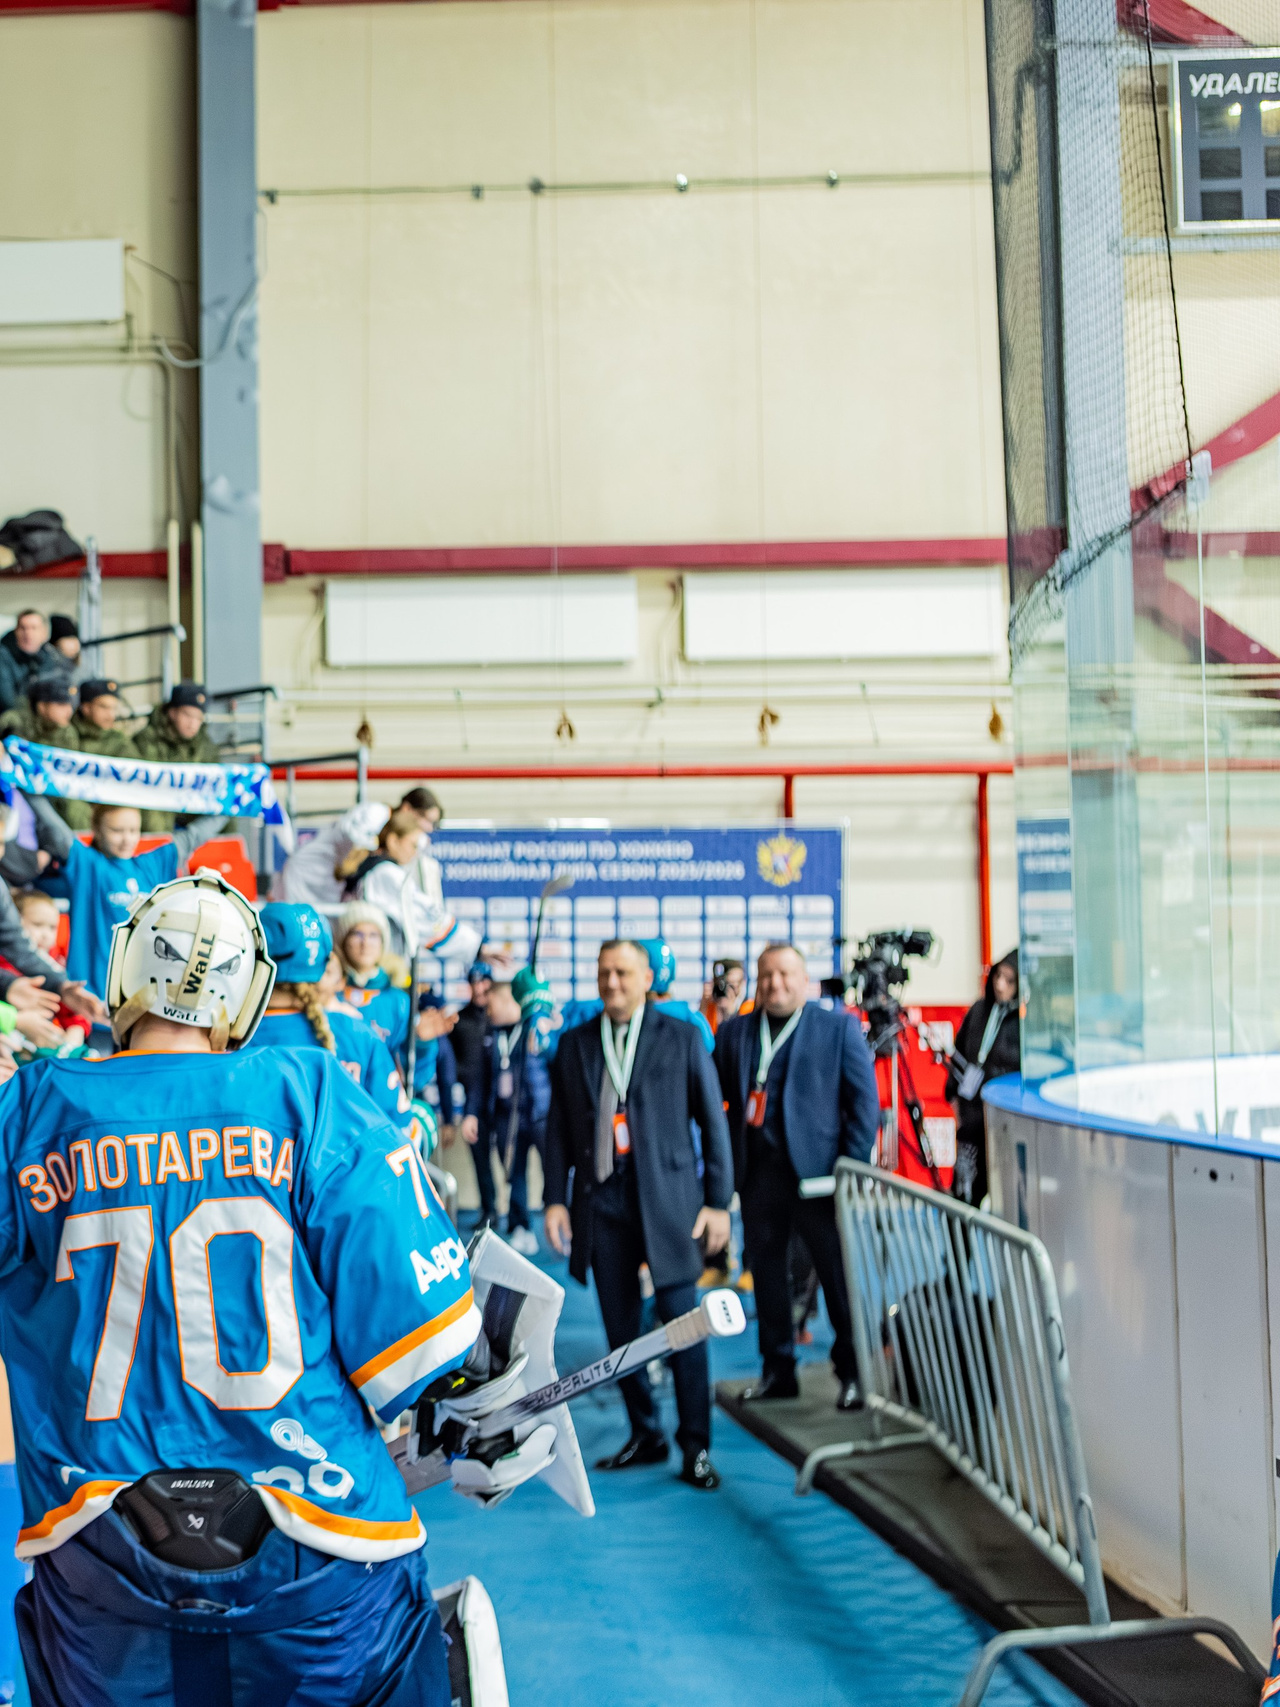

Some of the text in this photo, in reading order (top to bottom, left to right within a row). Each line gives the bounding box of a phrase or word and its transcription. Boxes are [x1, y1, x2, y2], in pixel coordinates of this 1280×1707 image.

[1188, 71, 1280, 99] УДАЛЕ
[428, 839, 694, 861] МПИОНАТ РОССИИ ПО ХОККЕЮ
[445, 860, 551, 882] ХОККЕЙНАЯ
[598, 860, 656, 882] СЕЗОН
[657, 860, 746, 882] 2025/2026
[19, 1126, 294, 1213] ЗОЛОТАРЕВА
[385, 1143, 445, 1219] 7
[409, 1237, 469, 1295] Авр
[55, 1196, 304, 1421] 70
